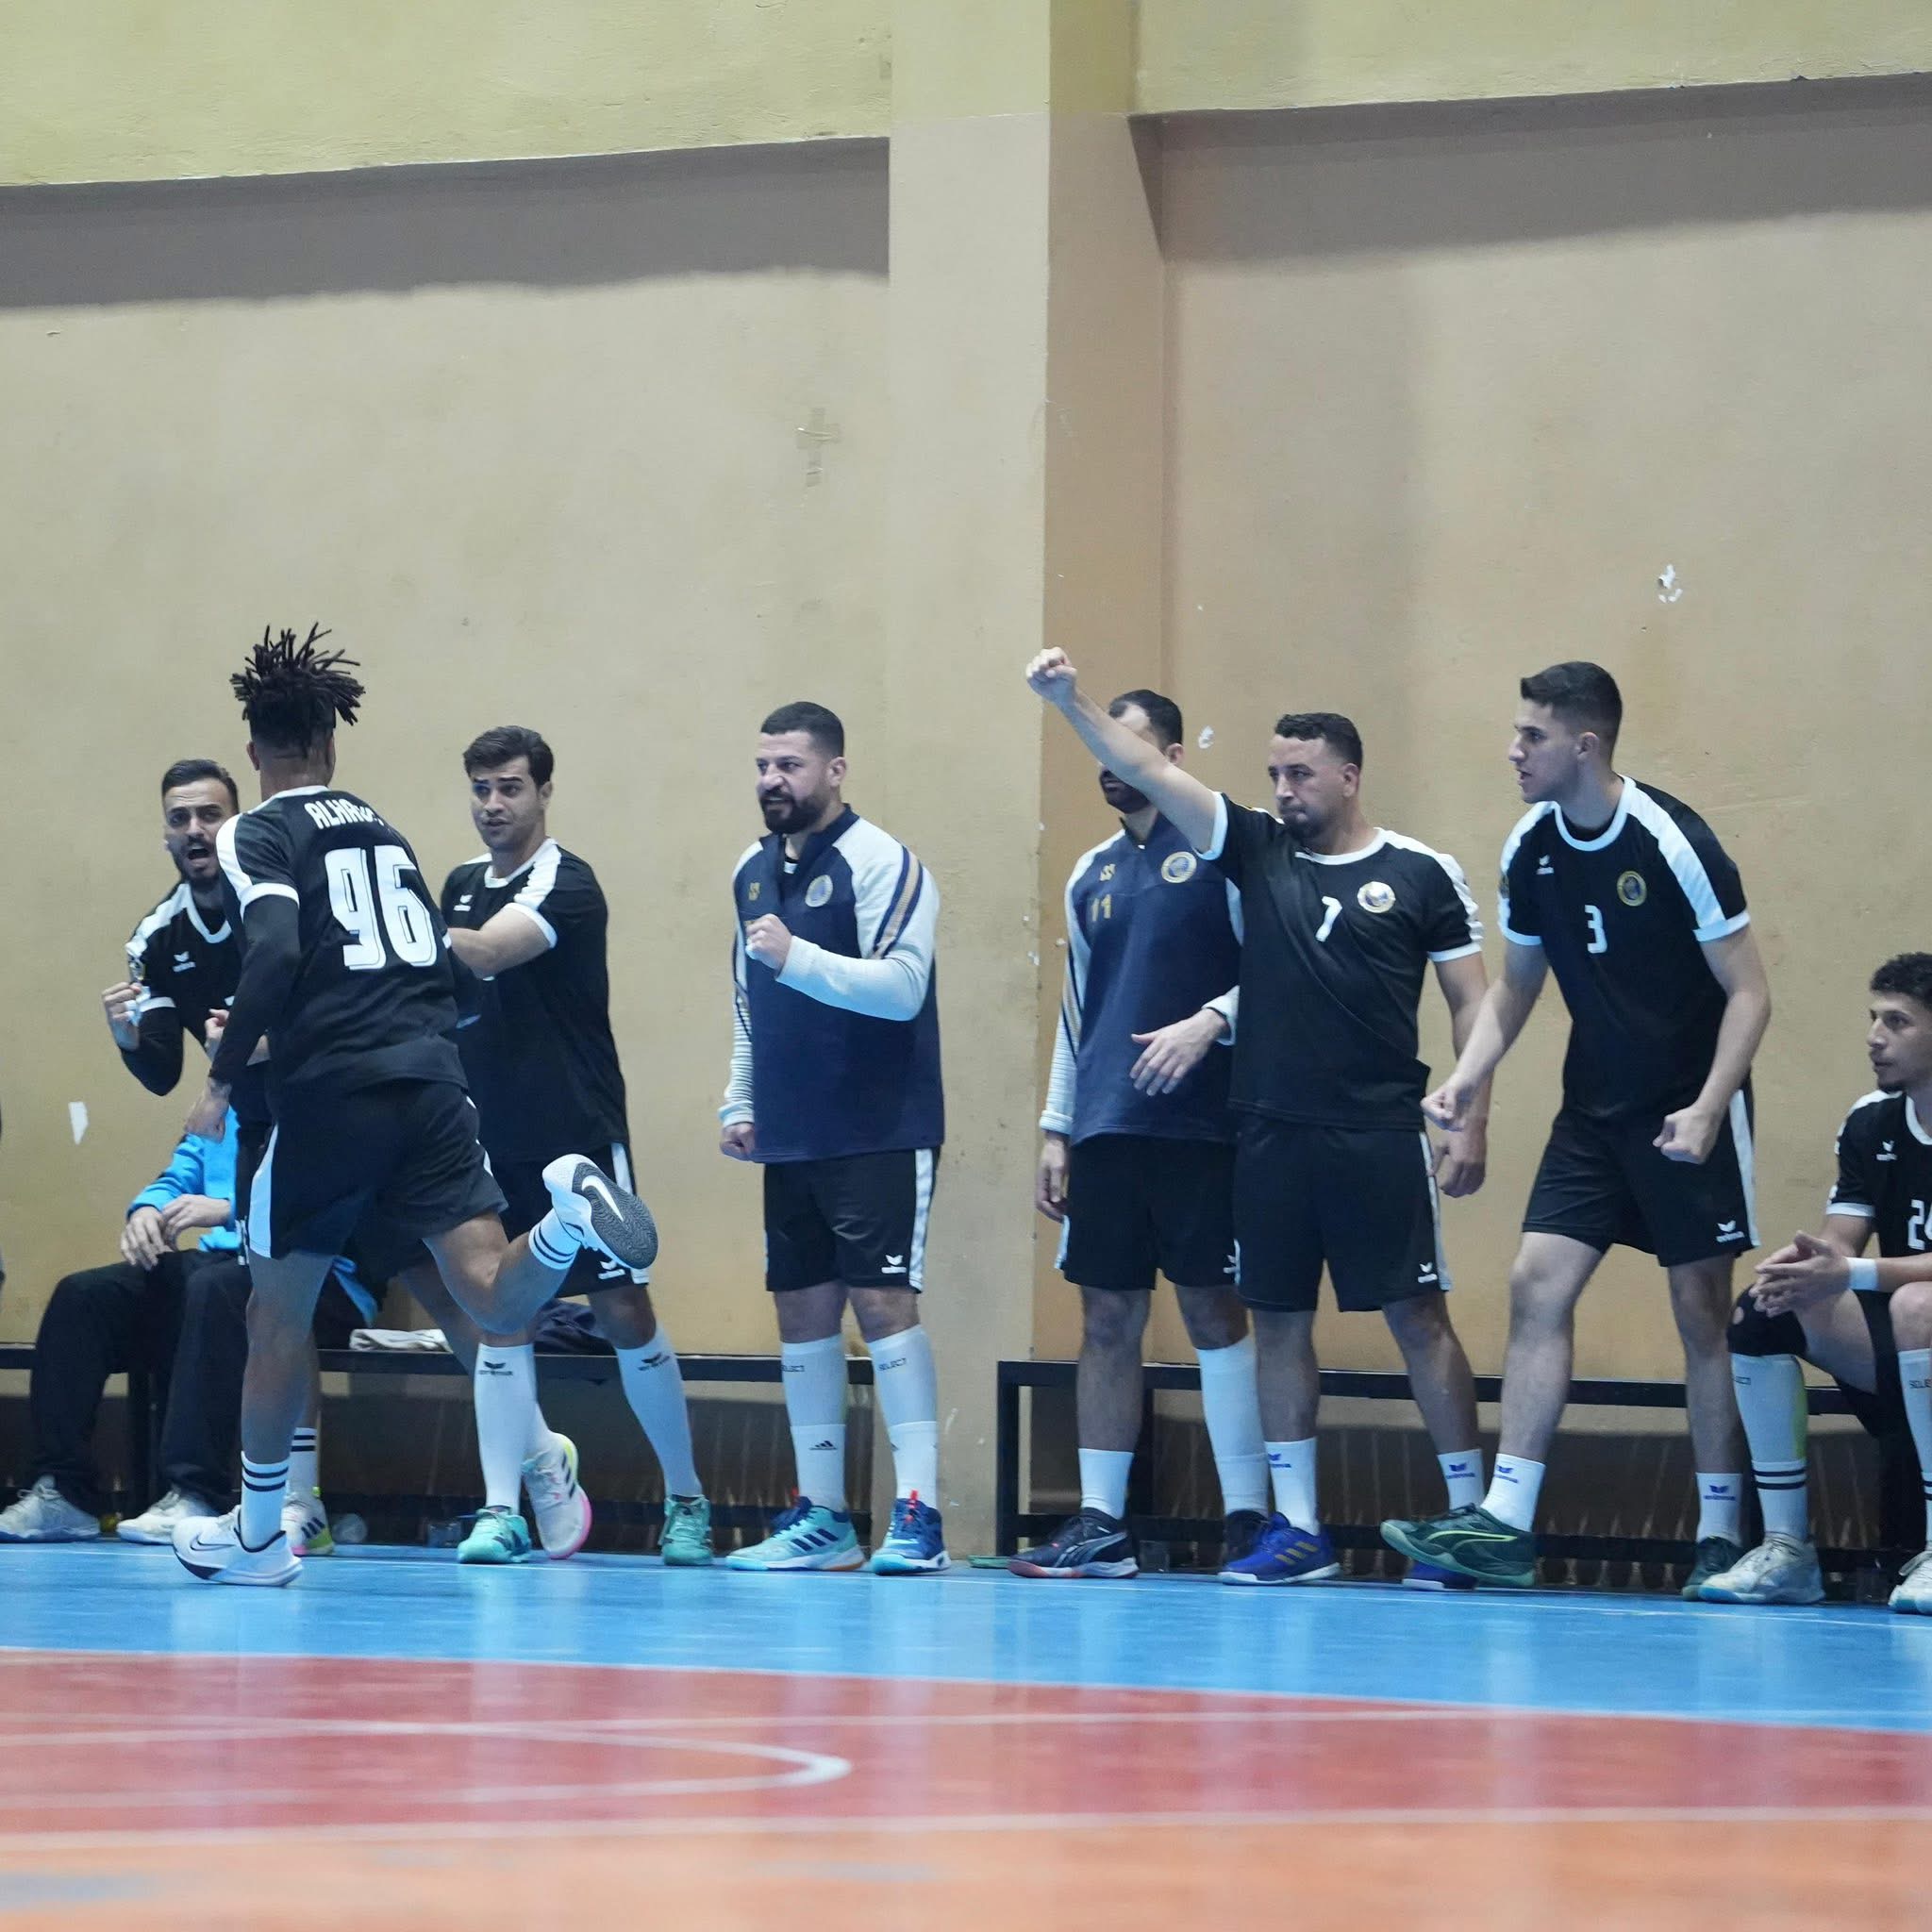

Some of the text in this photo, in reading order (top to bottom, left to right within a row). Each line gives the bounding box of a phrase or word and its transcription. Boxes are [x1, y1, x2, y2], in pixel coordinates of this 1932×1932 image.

[325, 845, 438, 971] 96
[1315, 895, 1343, 942] 7
[1584, 904, 1608, 955] 3
